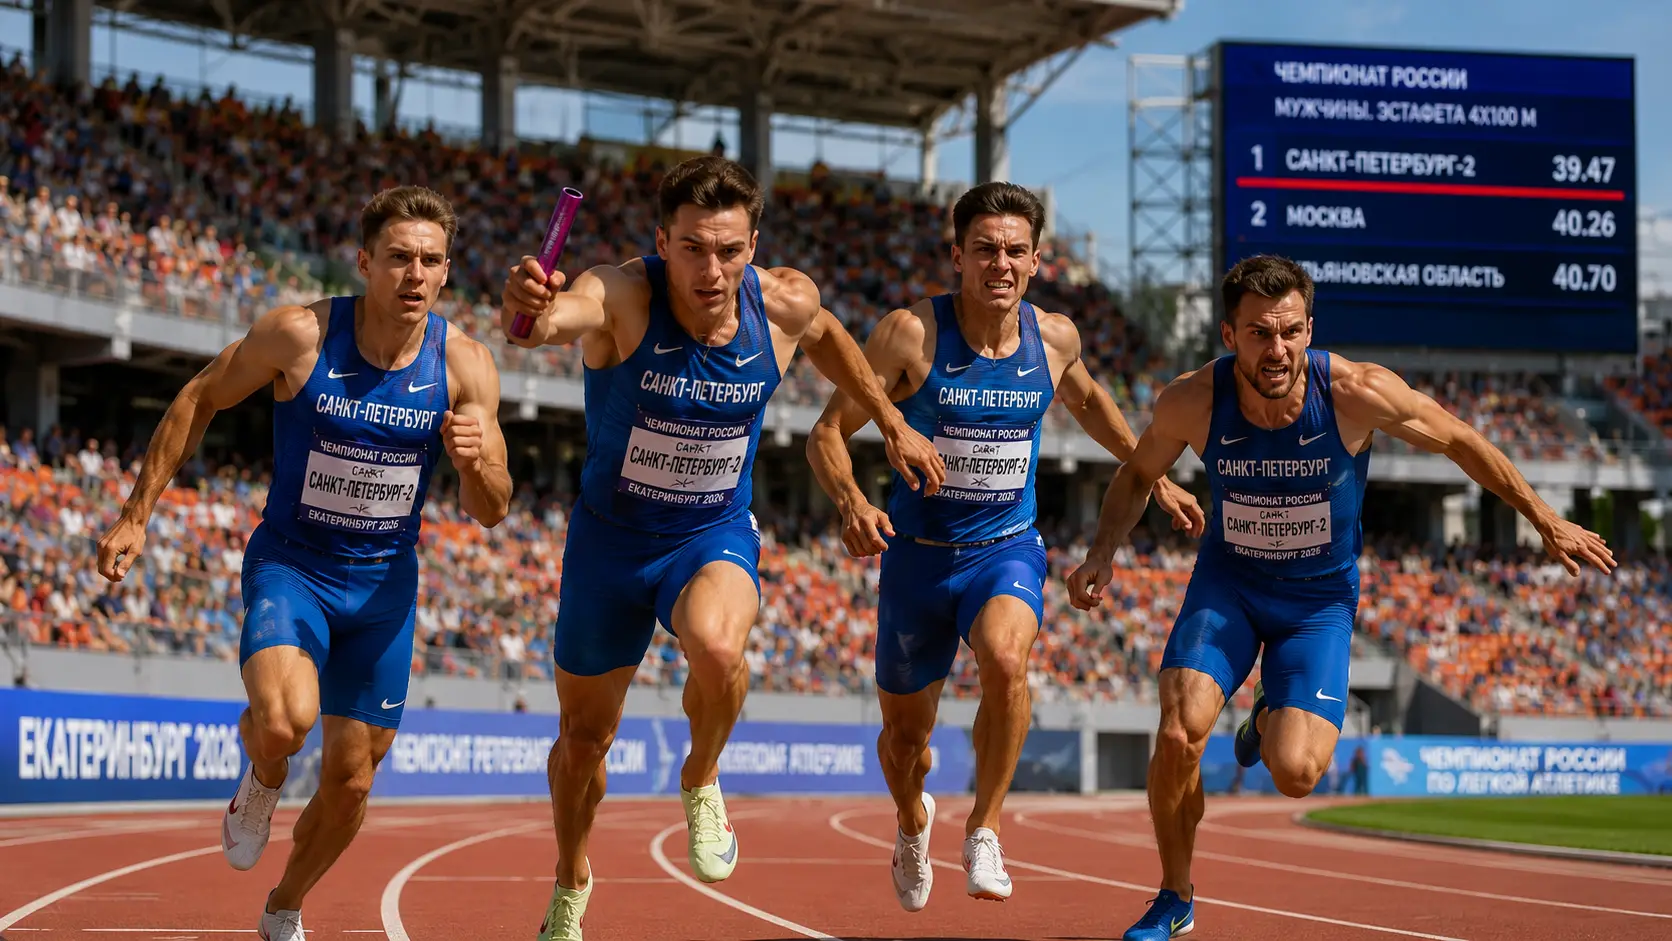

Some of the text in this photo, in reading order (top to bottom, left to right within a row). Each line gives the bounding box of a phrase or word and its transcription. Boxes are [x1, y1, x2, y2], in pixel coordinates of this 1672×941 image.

[1274, 61, 1468, 90] ЧЕМПИОНАТ РОССИИ
[1274, 97, 1374, 121] МУЖЧИНЫ.
[1377, 101, 1466, 124] ЭСТАФЕТА
[1521, 107, 1537, 128] М
[1251, 145, 1615, 184] 1 САНКТ-ПЕТЕРБУРГ-2 39.47
[1250, 201, 1616, 238] 2 МОСКВА 40.26
[1295, 260, 1616, 292] ЛЬЯНОВСКАЯ ОБЛАСТЬ 40.70
[640, 370, 766, 404] САНКТ-ПЕТЕРБУРГ
[938, 386, 1043, 409] САНКТ-ПЕТЕРБУРГ
[316, 393, 437, 430] САНКТ-ПЕТЕРБУРГ
[644, 416, 746, 438] ЧЕМПИОНАТ РОССИИ
[943, 425, 1029, 440] ЧЕМПИОНАТ РОССИИ
[320, 440, 418, 464] ЧЕМПИОНАТ РОССИИ
[630, 445, 742, 476] САНКТ-ПЕТЕРБУРГ-2
[1217, 457, 1331, 478] САНКТ-ПЕТЕРБУРГ
[309, 470, 414, 502] САНКТ-ПЕТЕРБУРГ-2
[628, 482, 724, 505] ЕКАТЕРИНБУРГ 2026
[997, 491, 1015, 502] 2026
[1229, 491, 1322, 506] ЧЕМПИОНАТ РОССИИ
[308, 509, 399, 531] ЕКАТЕРИНБУРГ 2026
[1227, 516, 1326, 537] САНКТ-ПЕТЕРБУРГ-2
[1234, 545, 1298, 560] ЕКАТЕРИНБУРГ
[18, 715, 193, 780] ЕКАТЕРИНБУРГ
